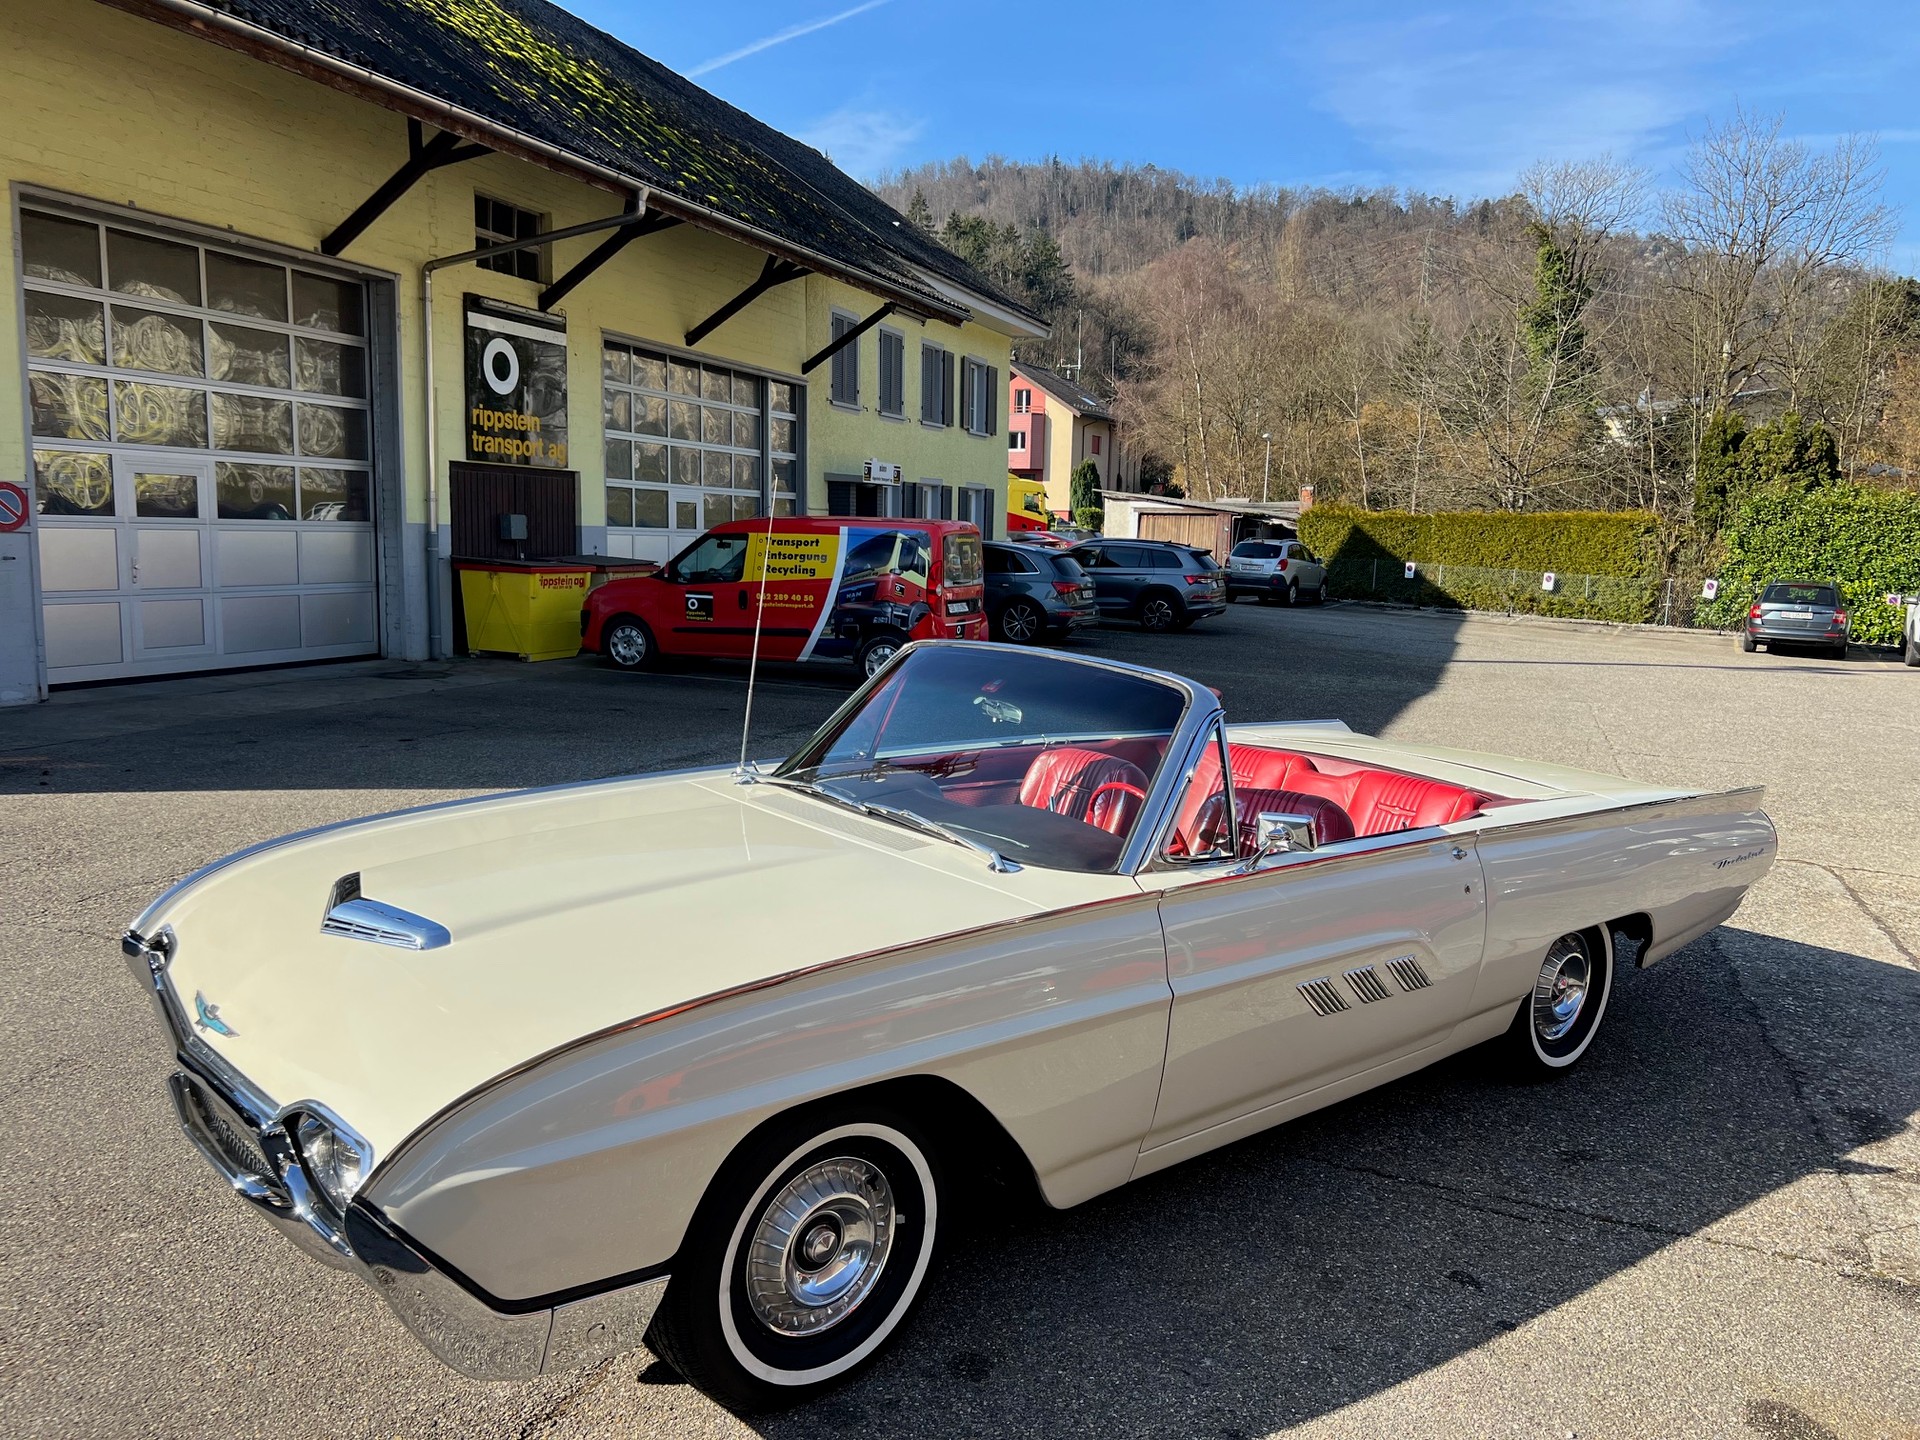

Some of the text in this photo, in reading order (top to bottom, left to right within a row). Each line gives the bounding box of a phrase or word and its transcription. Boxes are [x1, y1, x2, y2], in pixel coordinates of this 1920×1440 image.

[471, 403, 541, 433] rippstein
[472, 430, 567, 465] transport ag
[765, 536, 820, 549] Transport
[765, 550, 827, 563] Entsorgung
[765, 564, 816, 577] Recycling
[574, 577, 585, 588] ag
[773, 593, 789, 601] 289
[791, 594, 802, 602] 40
[803, 594, 814, 602] 50
